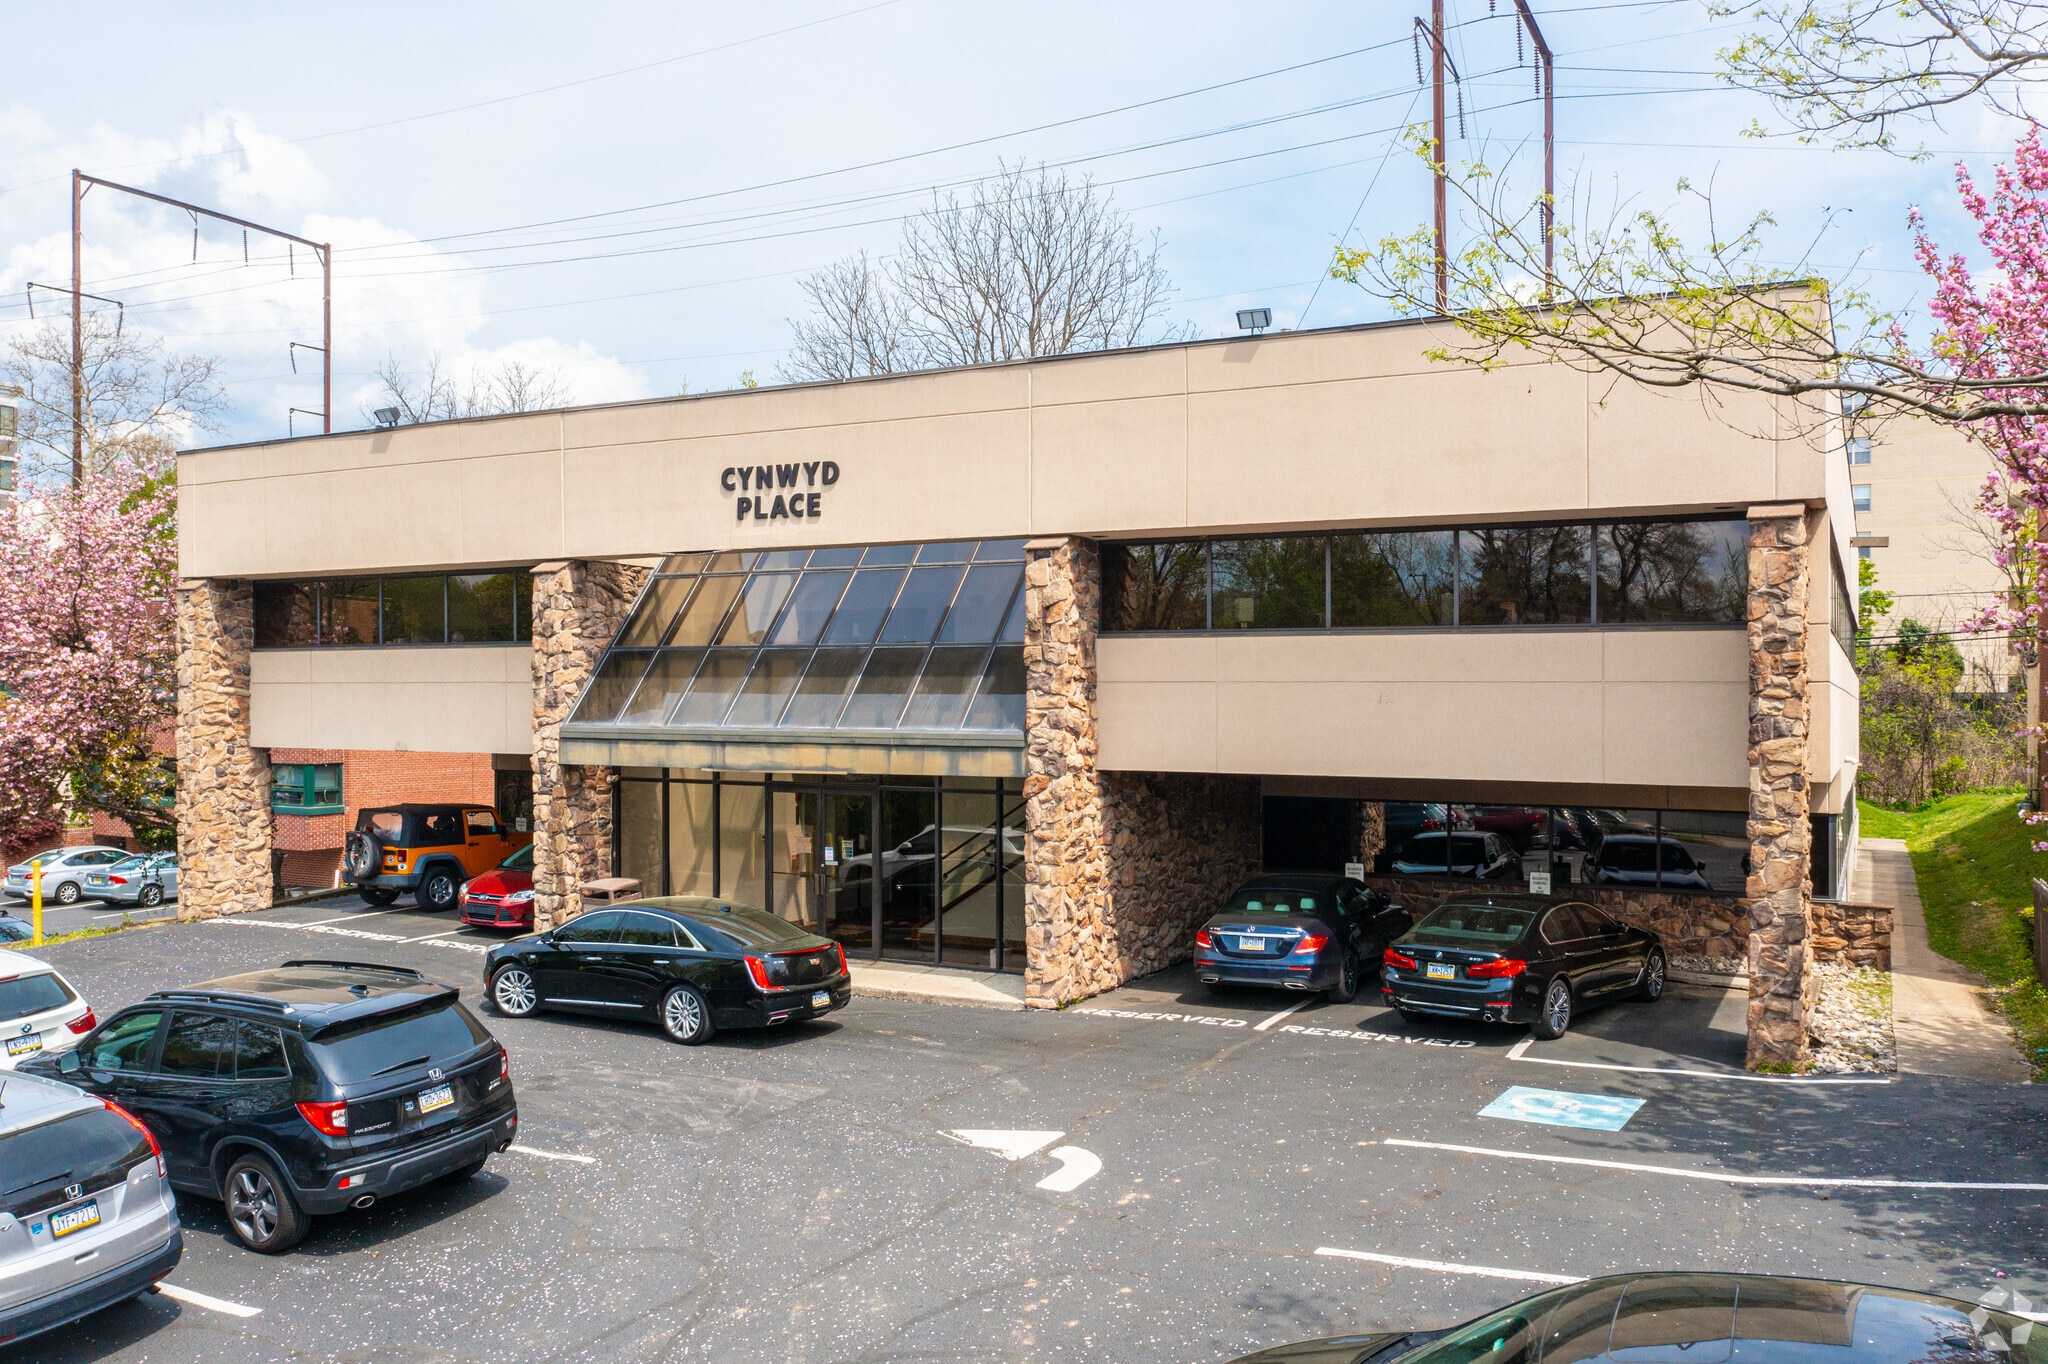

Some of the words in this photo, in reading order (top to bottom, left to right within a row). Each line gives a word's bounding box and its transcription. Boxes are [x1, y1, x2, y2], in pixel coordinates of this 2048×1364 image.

[721, 461, 840, 491] CYNWYD
[737, 493, 821, 520] PLACE
[303, 925, 407, 941] RESERVED
[419, 940, 487, 954] RESER
[1072, 1007, 1248, 1028] RESERVED
[1278, 1024, 1477, 1049] RESERVED
[354, 1121, 392, 1135] PASSPORT
